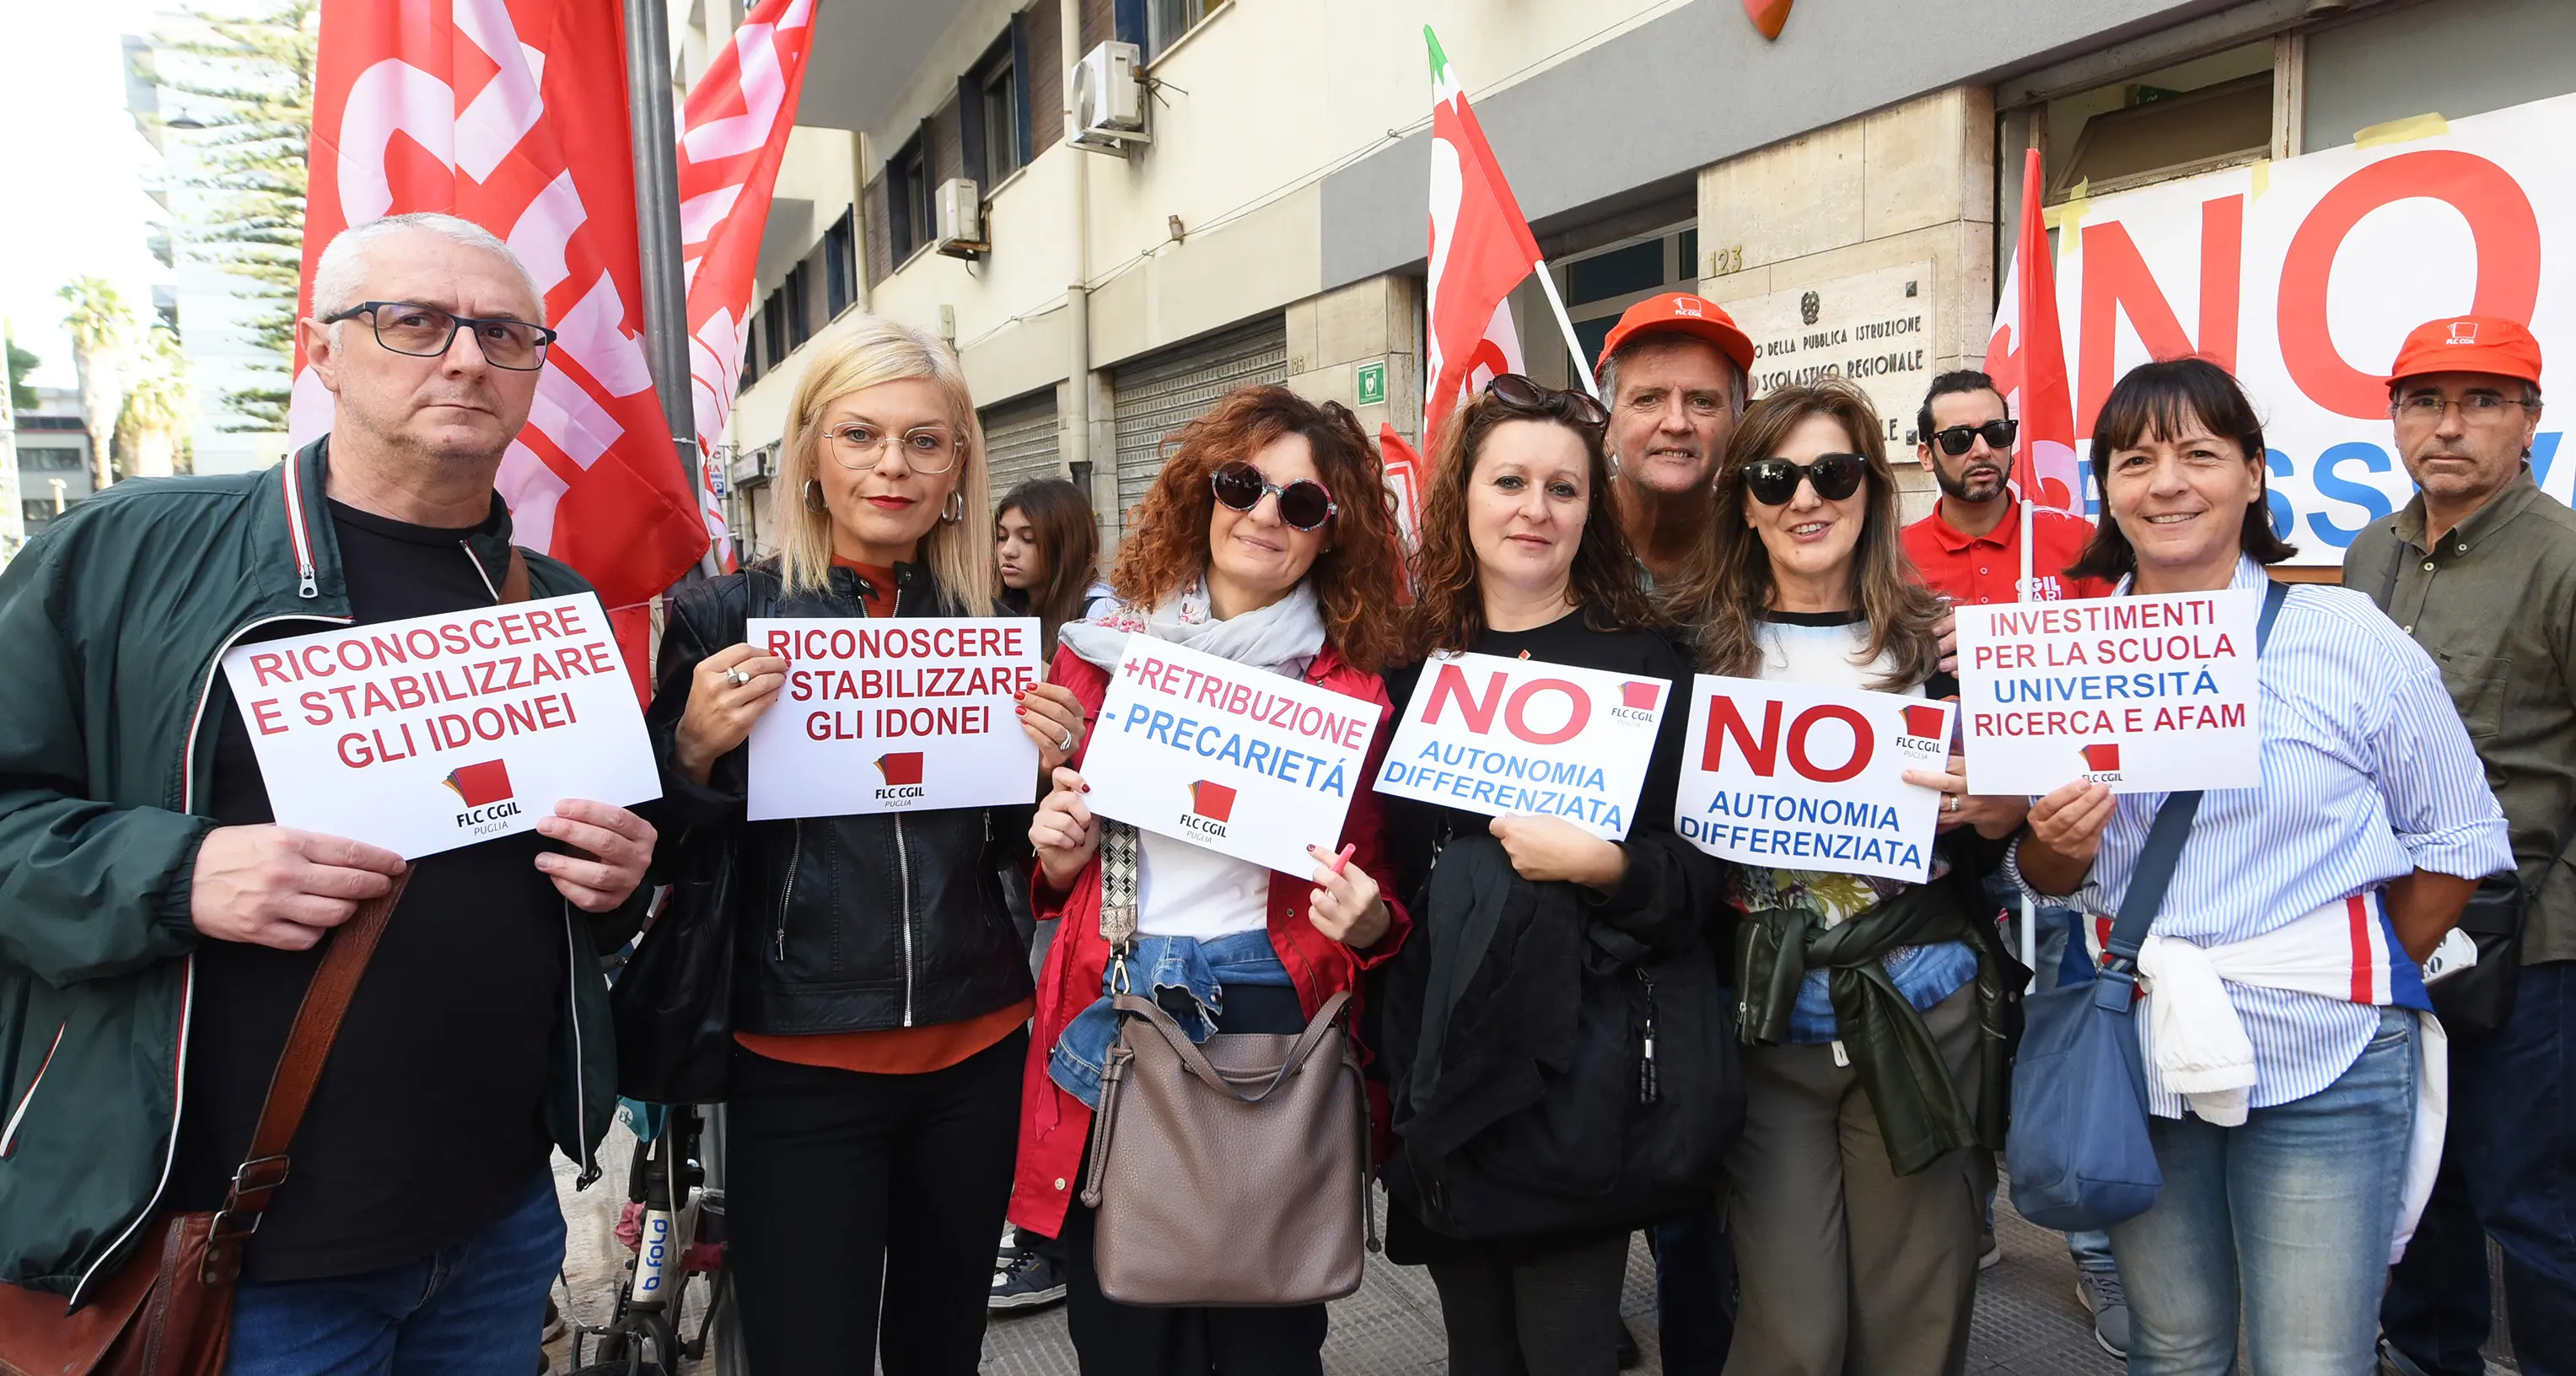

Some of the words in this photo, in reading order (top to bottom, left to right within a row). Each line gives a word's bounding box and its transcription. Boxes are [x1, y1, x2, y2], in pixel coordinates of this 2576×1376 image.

[1710, 245, 1742, 277] 123
[2076, 150, 2541, 439] NO
[1767, 338, 1796, 357] DELLA
[1803, 329, 1847, 350] PUBBLICA
[1856, 315, 1921, 341] ISTRUZIONE
[1762, 363, 1840, 391] SCOLASTICO
[1847, 350, 1923, 379] REGIONALE
[1991, 600, 2214, 637] INVESTIMENTI
[250, 605, 588, 687] RICONOSCERE
[767, 628, 1023, 660] RICONOSCERE
[1975, 643, 2037, 669] PER
[2047, 642, 2088, 666] LA
[2097, 633, 2236, 664] SCUOLA
[251, 698, 289, 736] E
[299, 642, 616, 726] STABILIZZARE
[791, 666, 1034, 701] STABILIZZARE
[1994, 664, 2219, 703] UNIVERSITÁ
[1123, 657, 1367, 750] +RETRIBUZIONE
[1420, 663, 1591, 745] NO
[1611, 707, 1630, 719] FLC
[1631, 711, 1654, 723] CGIL
[1974, 710, 2115, 737] RICERCA
[2124, 708, 2143, 733] E
[2154, 702, 2246, 732] AFAM
[337, 723, 417, 769] GLI
[425, 692, 578, 752] IDONEI
[806, 710, 863, 741] GLI
[876, 706, 990, 738] IDONEI
[1701, 694, 1875, 783] NO
[1123, 702, 1347, 798] PRECARIETÁ
[1896, 736, 1915, 750] FLC
[1917, 740, 1941, 754] CGIL
[1902, 749, 1928, 761] PUGLIA
[1418, 740, 1605, 793] AUTONOMIA
[2101, 773, 2123, 782] CGIL
[875, 788, 895, 800] FLC
[898, 786, 925, 798] CGIL
[885, 799, 912, 808] PUGLIA
[1384, 761, 1622, 833] DIFFERENZIATA
[1707, 790, 1901, 832] AUTONOMIA
[456, 809, 483, 828] FLC
[487, 801, 522, 824] CGIL
[473, 821, 508, 836] PUGLIA
[1179, 814, 1199, 830] FLC
[1202, 820, 1227, 838] CGIL
[1186, 830, 1213, 844] PUGLIA
[1680, 815, 1923, 870] DIFFERENZIATA
